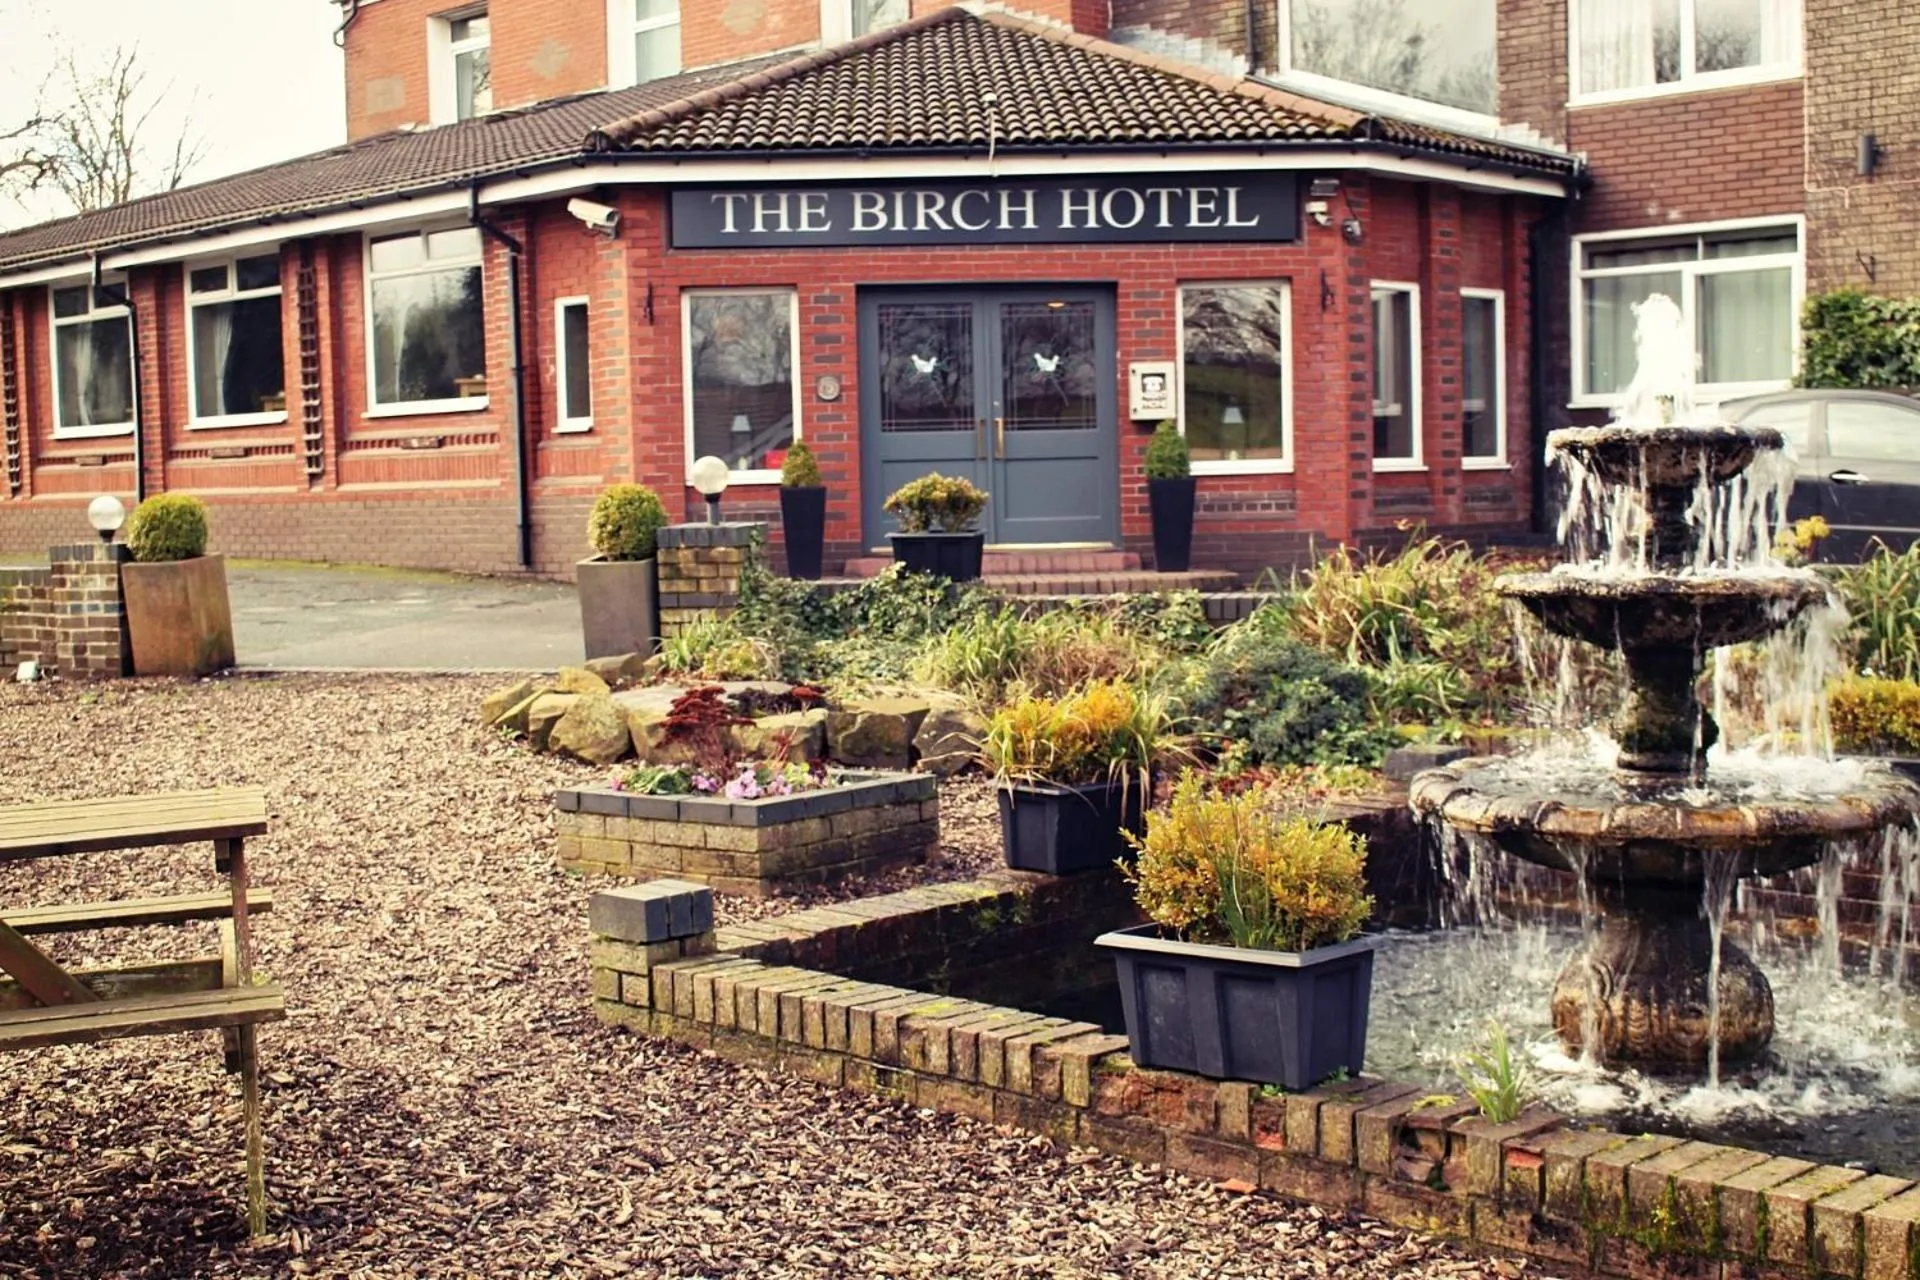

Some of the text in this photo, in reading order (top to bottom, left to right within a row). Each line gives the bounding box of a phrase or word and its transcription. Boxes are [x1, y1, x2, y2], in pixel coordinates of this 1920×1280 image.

[711, 187, 1260, 234] THE BIRCH HOTEL
